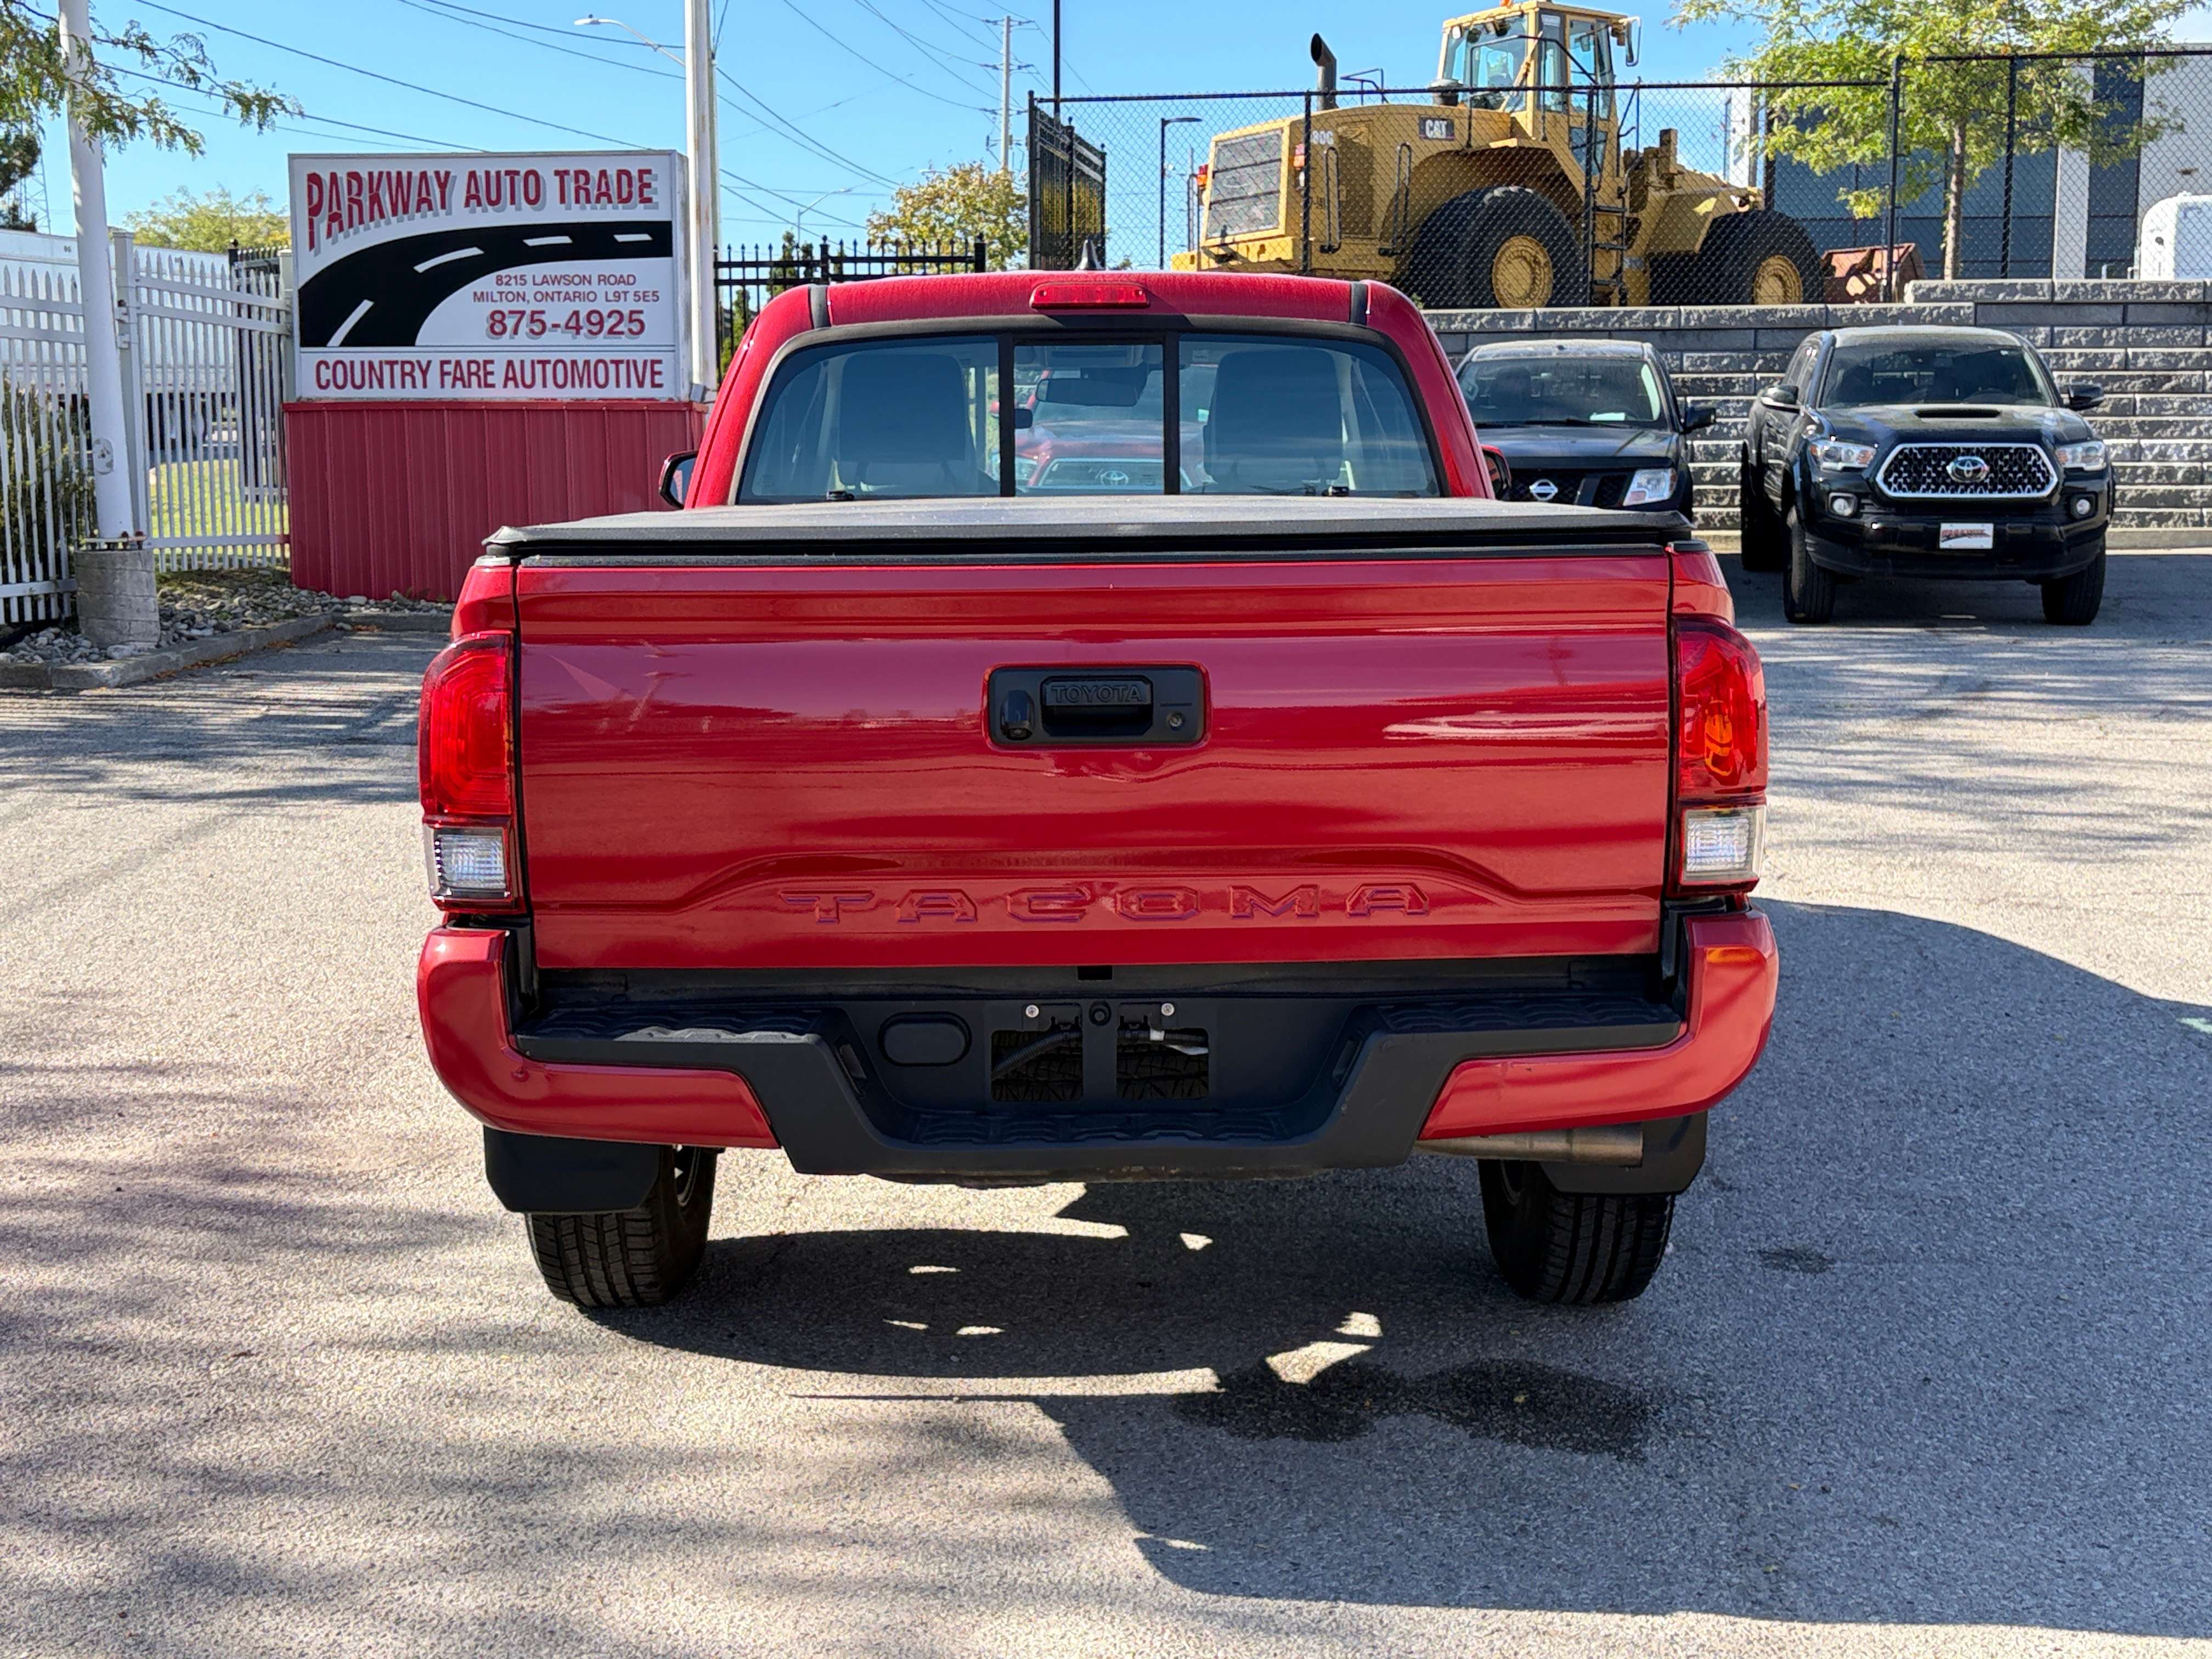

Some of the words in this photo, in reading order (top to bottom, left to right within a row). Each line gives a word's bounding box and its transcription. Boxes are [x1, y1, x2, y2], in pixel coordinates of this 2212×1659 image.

[1425, 120, 1447, 138] CAT
[306, 170, 452, 252] PARKWAY
[464, 168, 541, 208] AUTO
[554, 168, 654, 205] TRADE
[495, 274, 527, 286] 8215
[532, 274, 592, 286] LAWSON
[597, 274, 636, 286] ROAD
[473, 291, 531, 304] MILTON,
[533, 291, 597, 303] ONTARIO
[605, 291, 630, 302] L9T
[633, 291, 660, 302] 5E5
[488, 309, 646, 337] 875-4925
[315, 359, 432, 391] COUNTRY
[439, 359, 496, 389] FARE
[502, 358, 664, 390] AUTOMOTIVE
[1051, 684, 1143, 703] TOYOTA
[778, 882, 1430, 924] TACOMA
